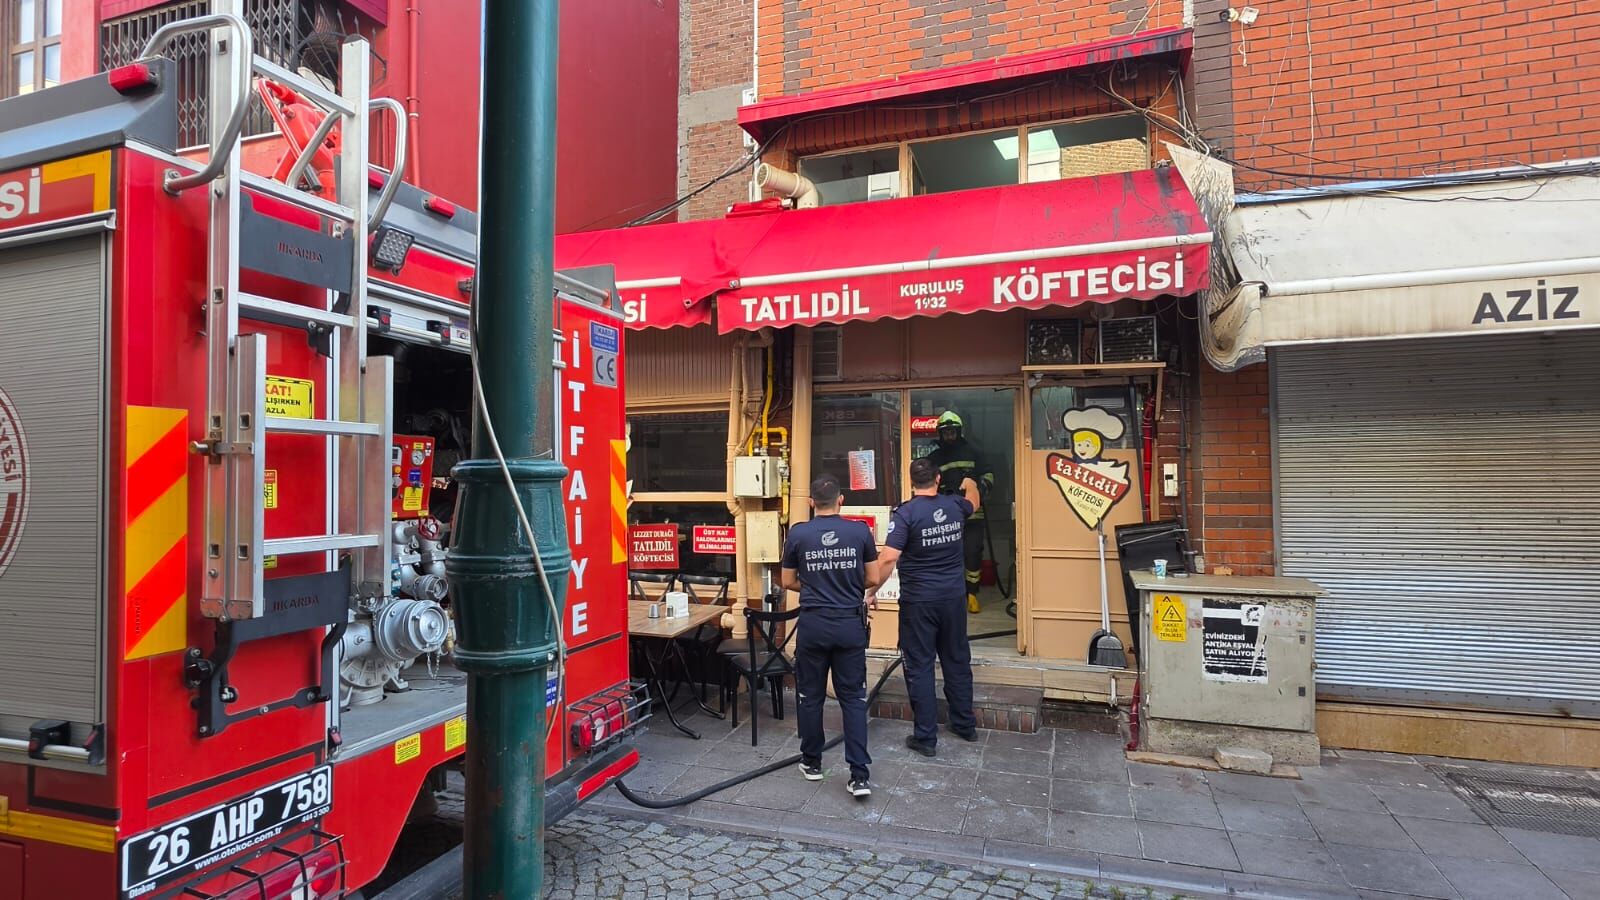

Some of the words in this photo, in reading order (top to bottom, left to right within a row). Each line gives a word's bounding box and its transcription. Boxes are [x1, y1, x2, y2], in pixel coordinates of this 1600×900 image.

[993, 252, 1184, 304] KÖFTECİSİ
[900, 279, 964, 297] KURULUŞ
[620, 294, 647, 323] Sİ
[741, 284, 870, 322] TATLIDİL
[914, 296, 947, 310] 1932
[1472, 279, 1580, 324] AZİZ
[568, 330, 589, 636] İTFAİYE
[1056, 459, 1118, 496] tatlıdil
[1068, 485, 1104, 508] KÖFTECİSİ
[921, 521, 961, 538] ESKİŞEHİR
[633, 538, 674, 552] TATLIDİL
[922, 531, 962, 547] İTFAİYESİ
[633, 552, 675, 562] KÖFTECİSİ
[805, 546, 857, 560] ESKİŞEHİR
[807, 559, 857, 571] İTFAİYESİ
[1205, 632, 1245, 641] EVİNİZDEKİ
[1205, 640, 1232, 648] ANTİKA
[1233, 642, 1256, 650] EŞYAL
[147, 826, 190, 876] 26
[210, 797, 264, 850] AHP
[281, 773, 327, 821] 758
